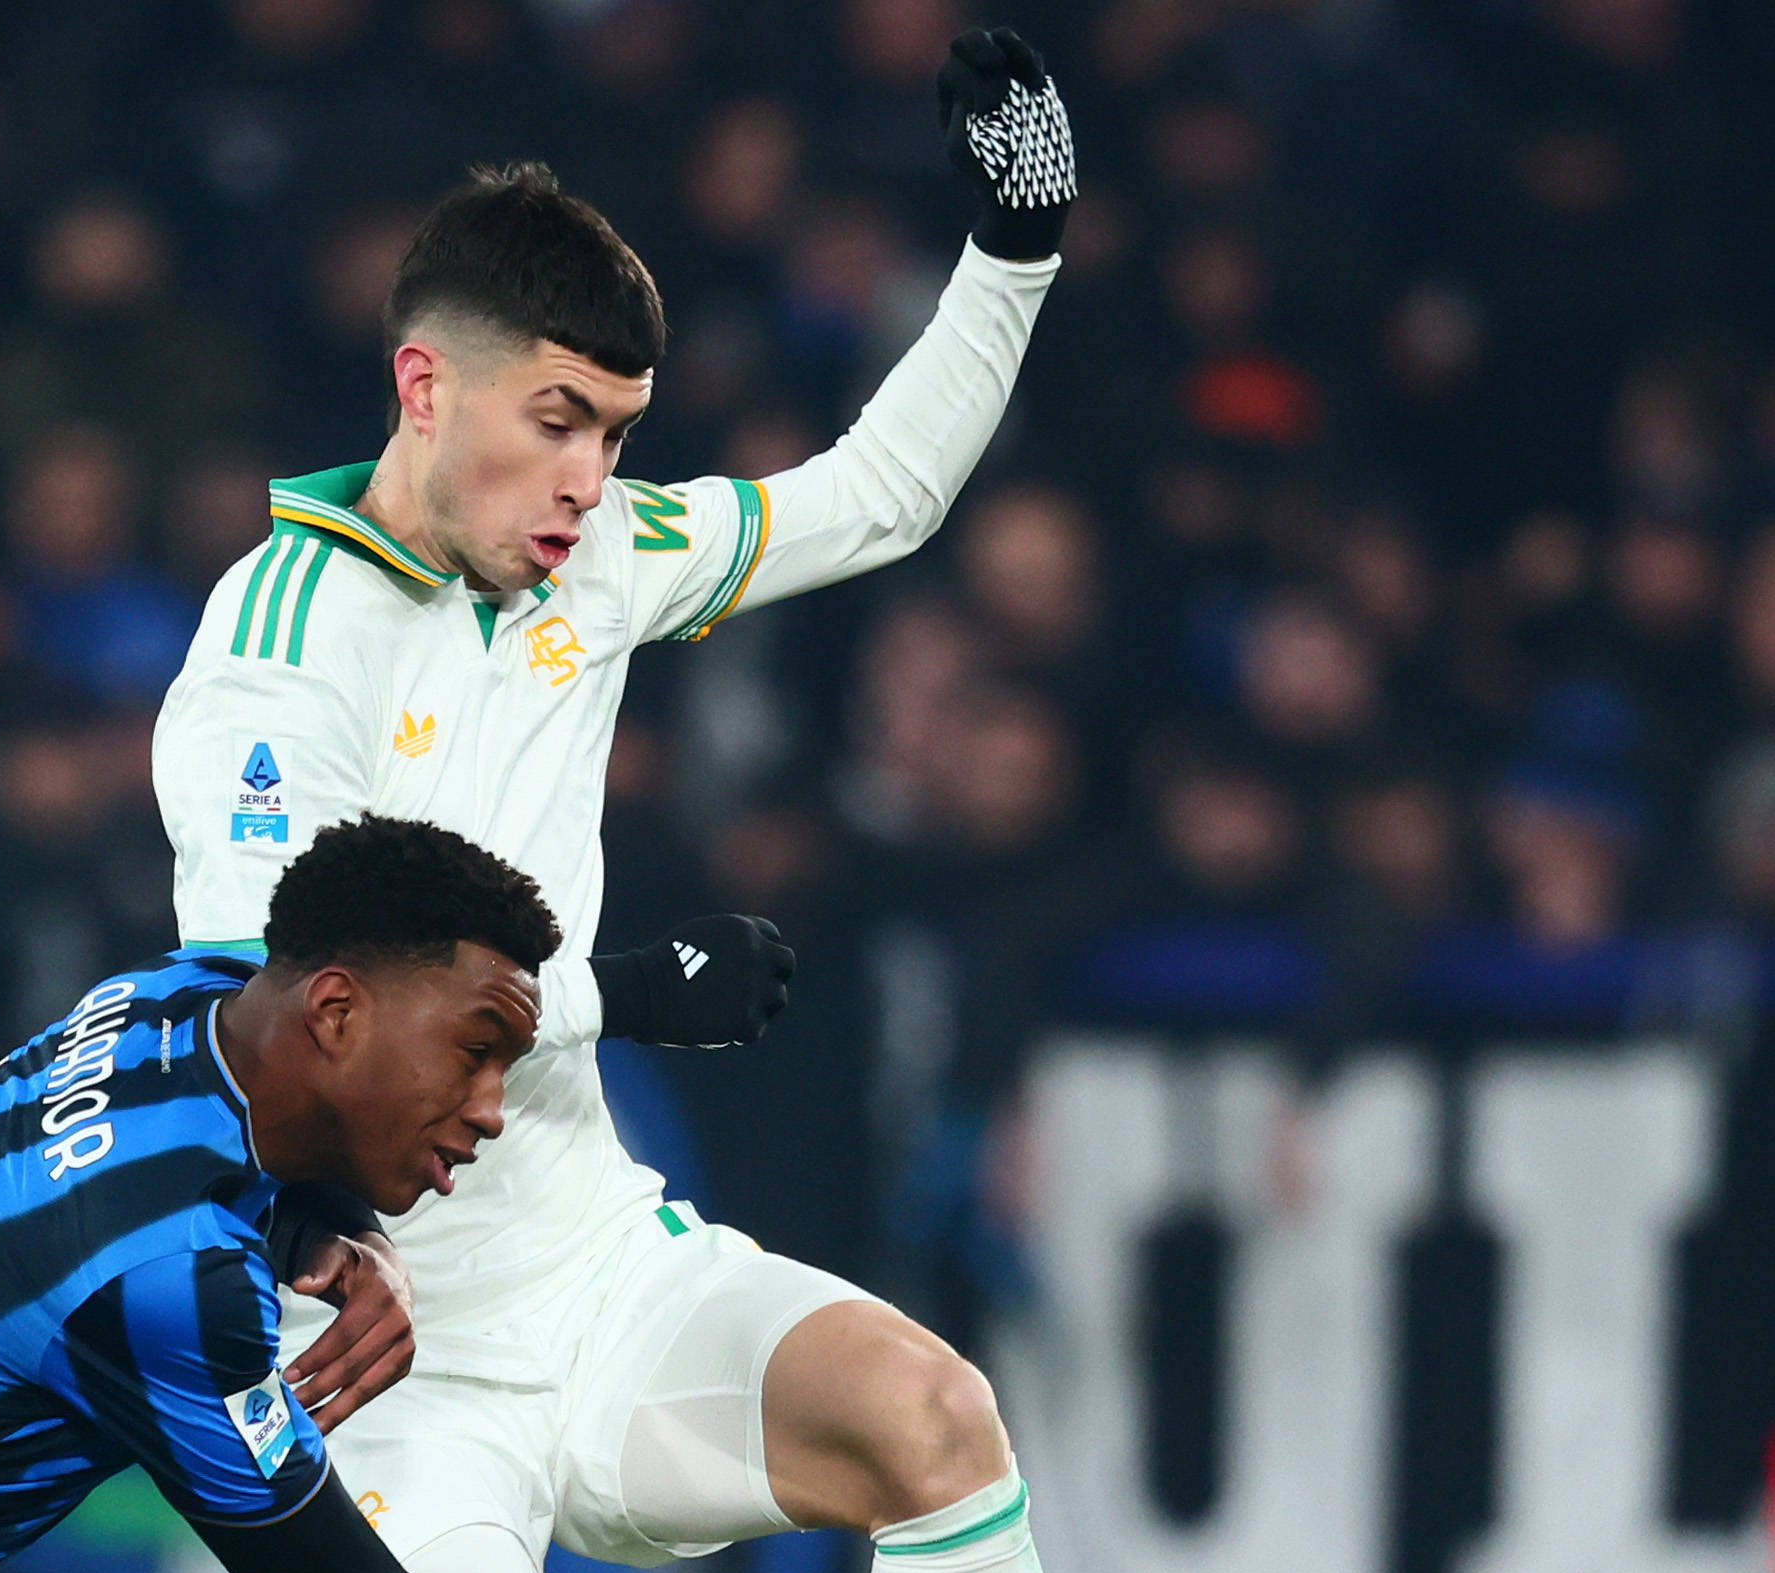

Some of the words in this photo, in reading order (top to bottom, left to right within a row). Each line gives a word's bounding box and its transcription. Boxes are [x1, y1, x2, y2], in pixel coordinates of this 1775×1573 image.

[239, 794, 271, 805] SERIE
[274, 796, 281, 805] A
[40, 979, 138, 1183] AHANOR
[254, 1418, 277, 1445] SERIE
